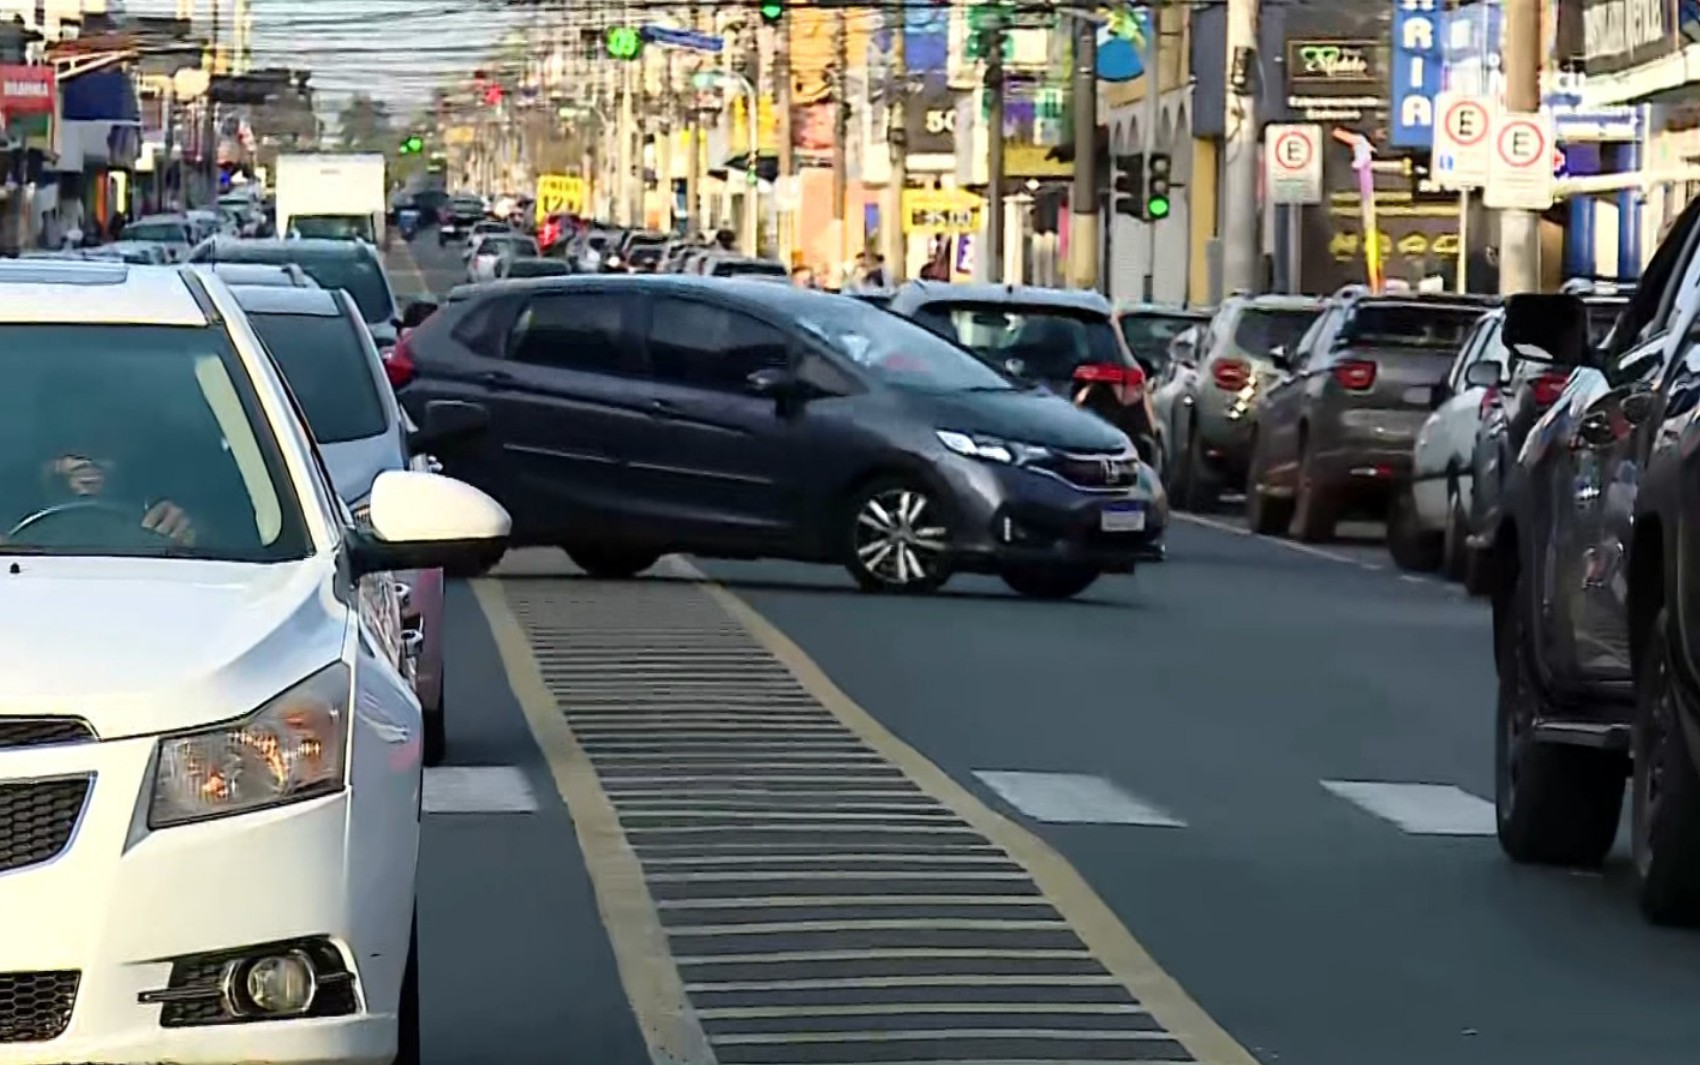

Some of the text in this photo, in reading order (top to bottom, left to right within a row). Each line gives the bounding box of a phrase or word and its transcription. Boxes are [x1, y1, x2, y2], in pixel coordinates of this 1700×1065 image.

[1459, 110, 1474, 136] E
[1287, 140, 1302, 161] E
[1513, 131, 1530, 156] E
